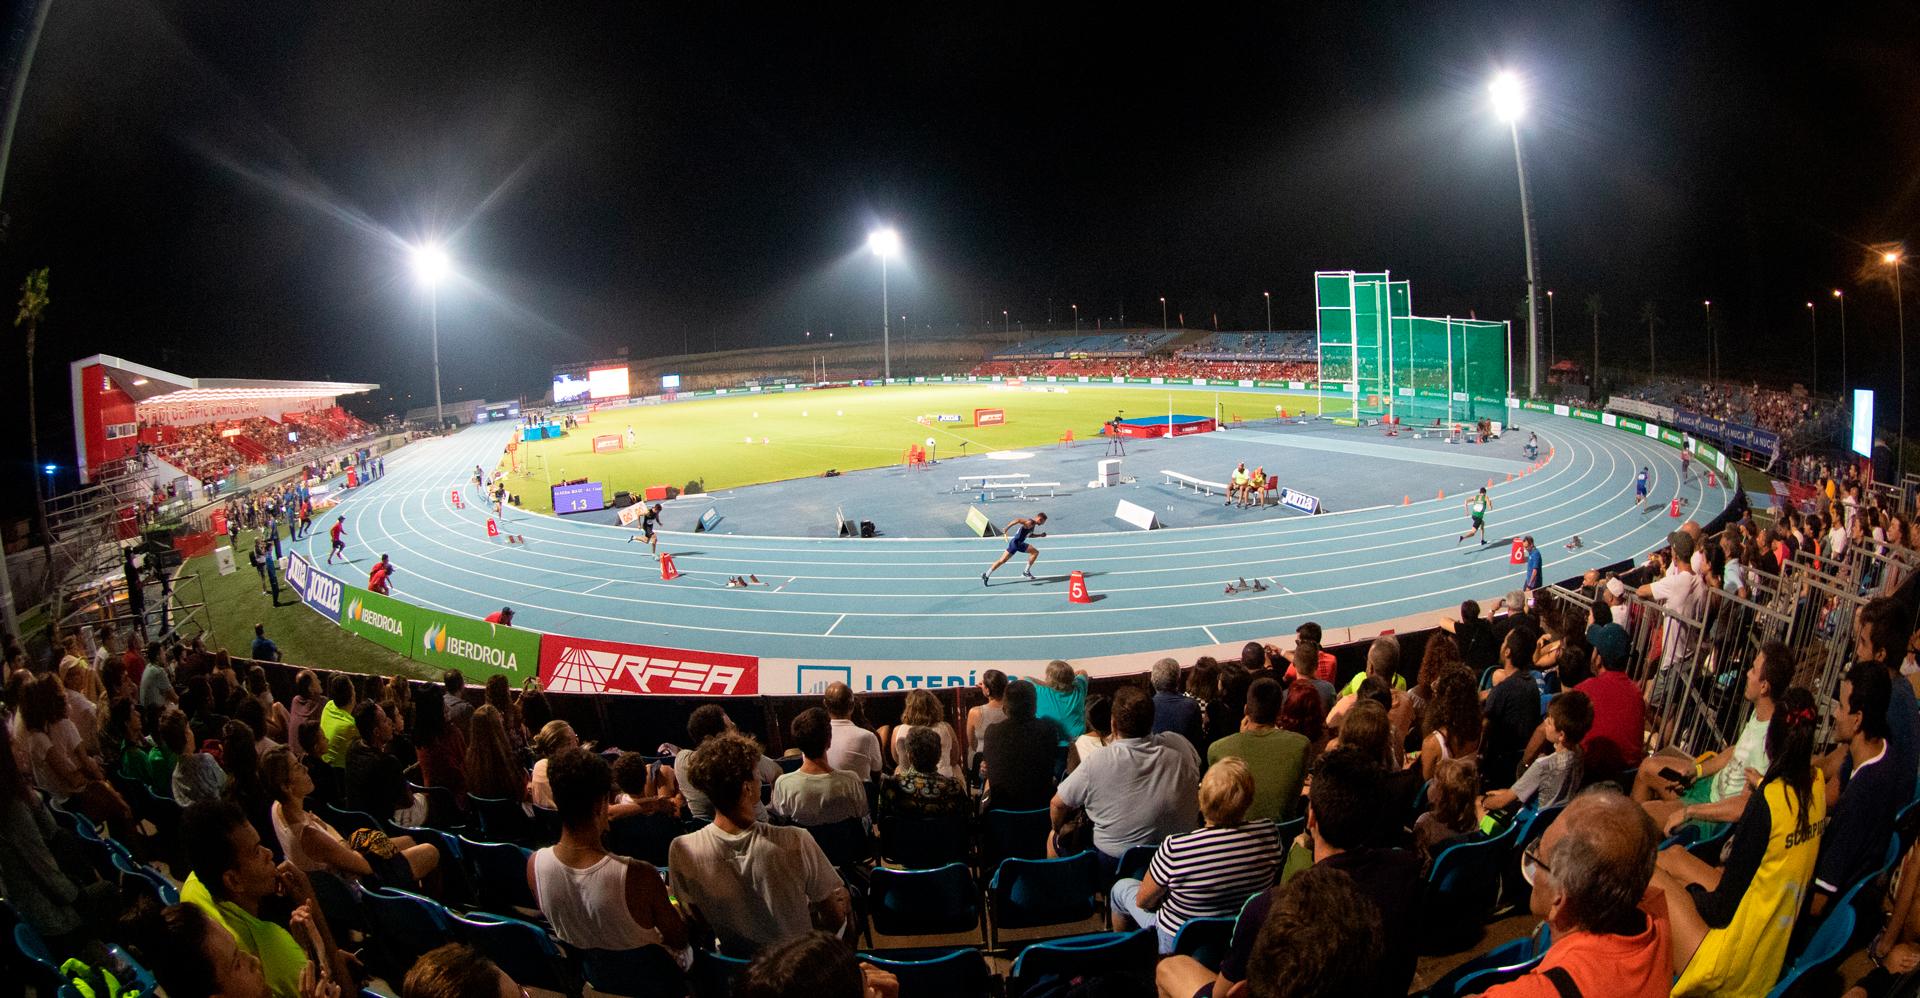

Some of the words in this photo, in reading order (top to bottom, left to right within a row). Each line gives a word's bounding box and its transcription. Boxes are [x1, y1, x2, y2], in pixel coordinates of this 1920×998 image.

[1673, 504, 1679, 514] 7
[489, 524, 496, 534] 3
[1514, 547, 1523, 560] 6
[668, 561, 675, 574] 4
[1072, 582, 1083, 598] 5
[361, 607, 403, 636] IBERDROLA
[447, 636, 518, 672] IBERDROLA
